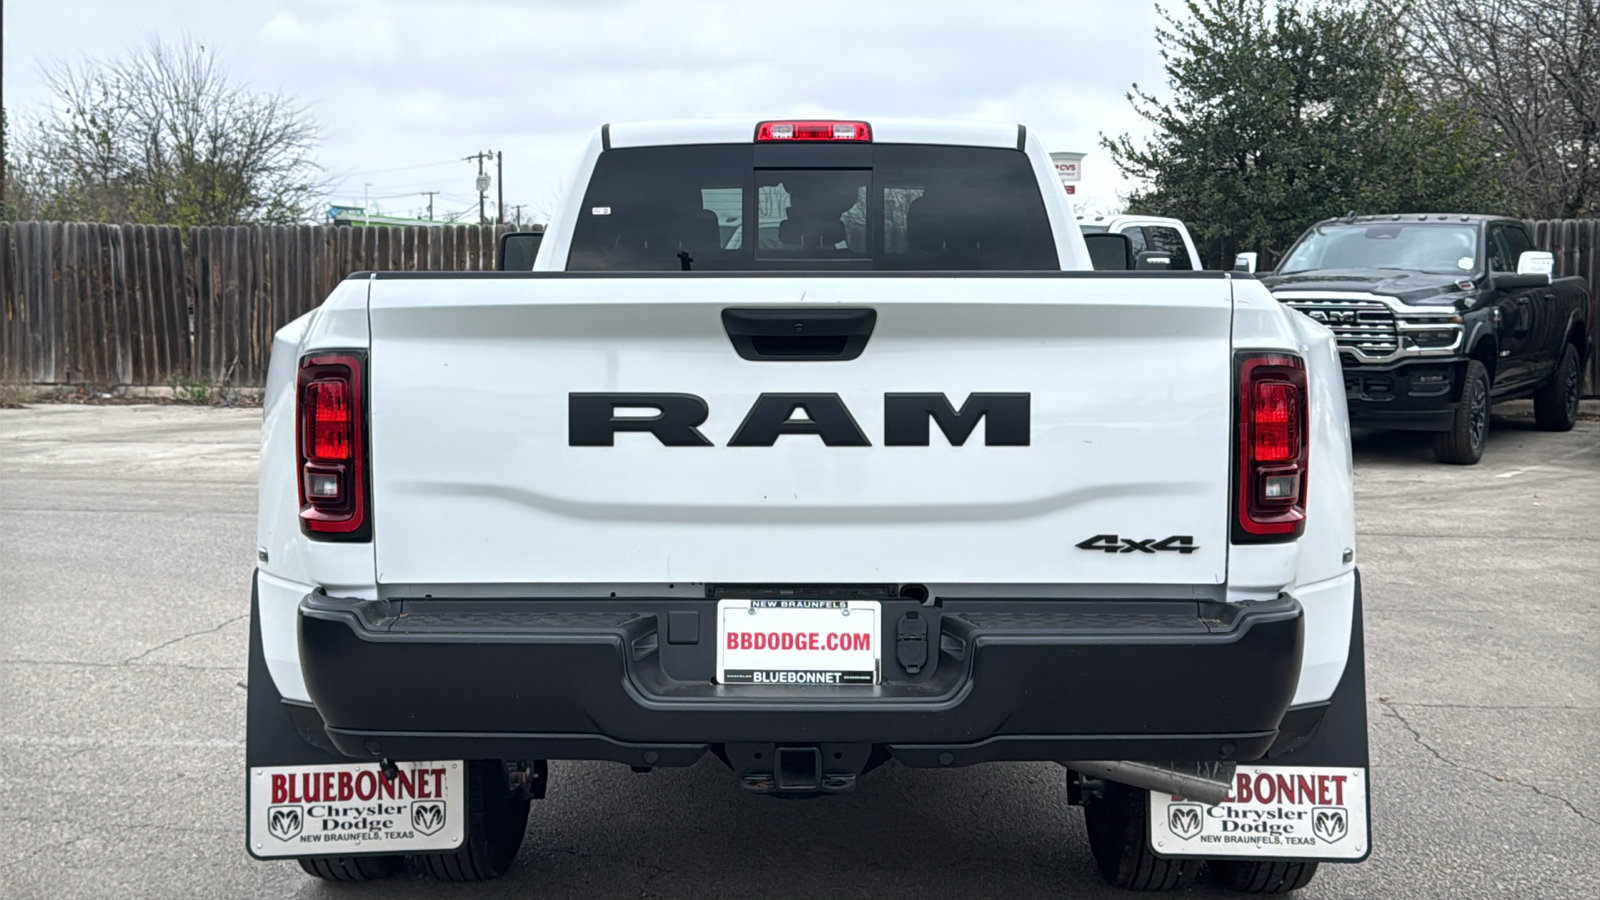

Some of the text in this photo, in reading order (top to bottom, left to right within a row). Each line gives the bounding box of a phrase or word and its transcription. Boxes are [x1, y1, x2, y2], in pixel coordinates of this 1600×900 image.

[1308, 311, 1354, 321] AM
[568, 392, 1031, 447] RAM
[1074, 534, 1200, 554] 4x4
[780, 601, 847, 609] BRAUNFELS
[726, 632, 871, 651] BBDODGE.COM
[753, 671, 843, 684] BLUEBONNET
[271, 768, 447, 804] BLUEBONNET
[306, 803, 408, 820] Chrysler
[1206, 806, 1308, 822] Chrysler
[321, 818, 394, 832] Dodge
[1222, 820, 1295, 836] Dodge
[300, 830, 415, 843] NEW BRAUNFELS, TEXAS
[1200, 834, 1316, 846] NEW BRAUNFELS, TEXAS
